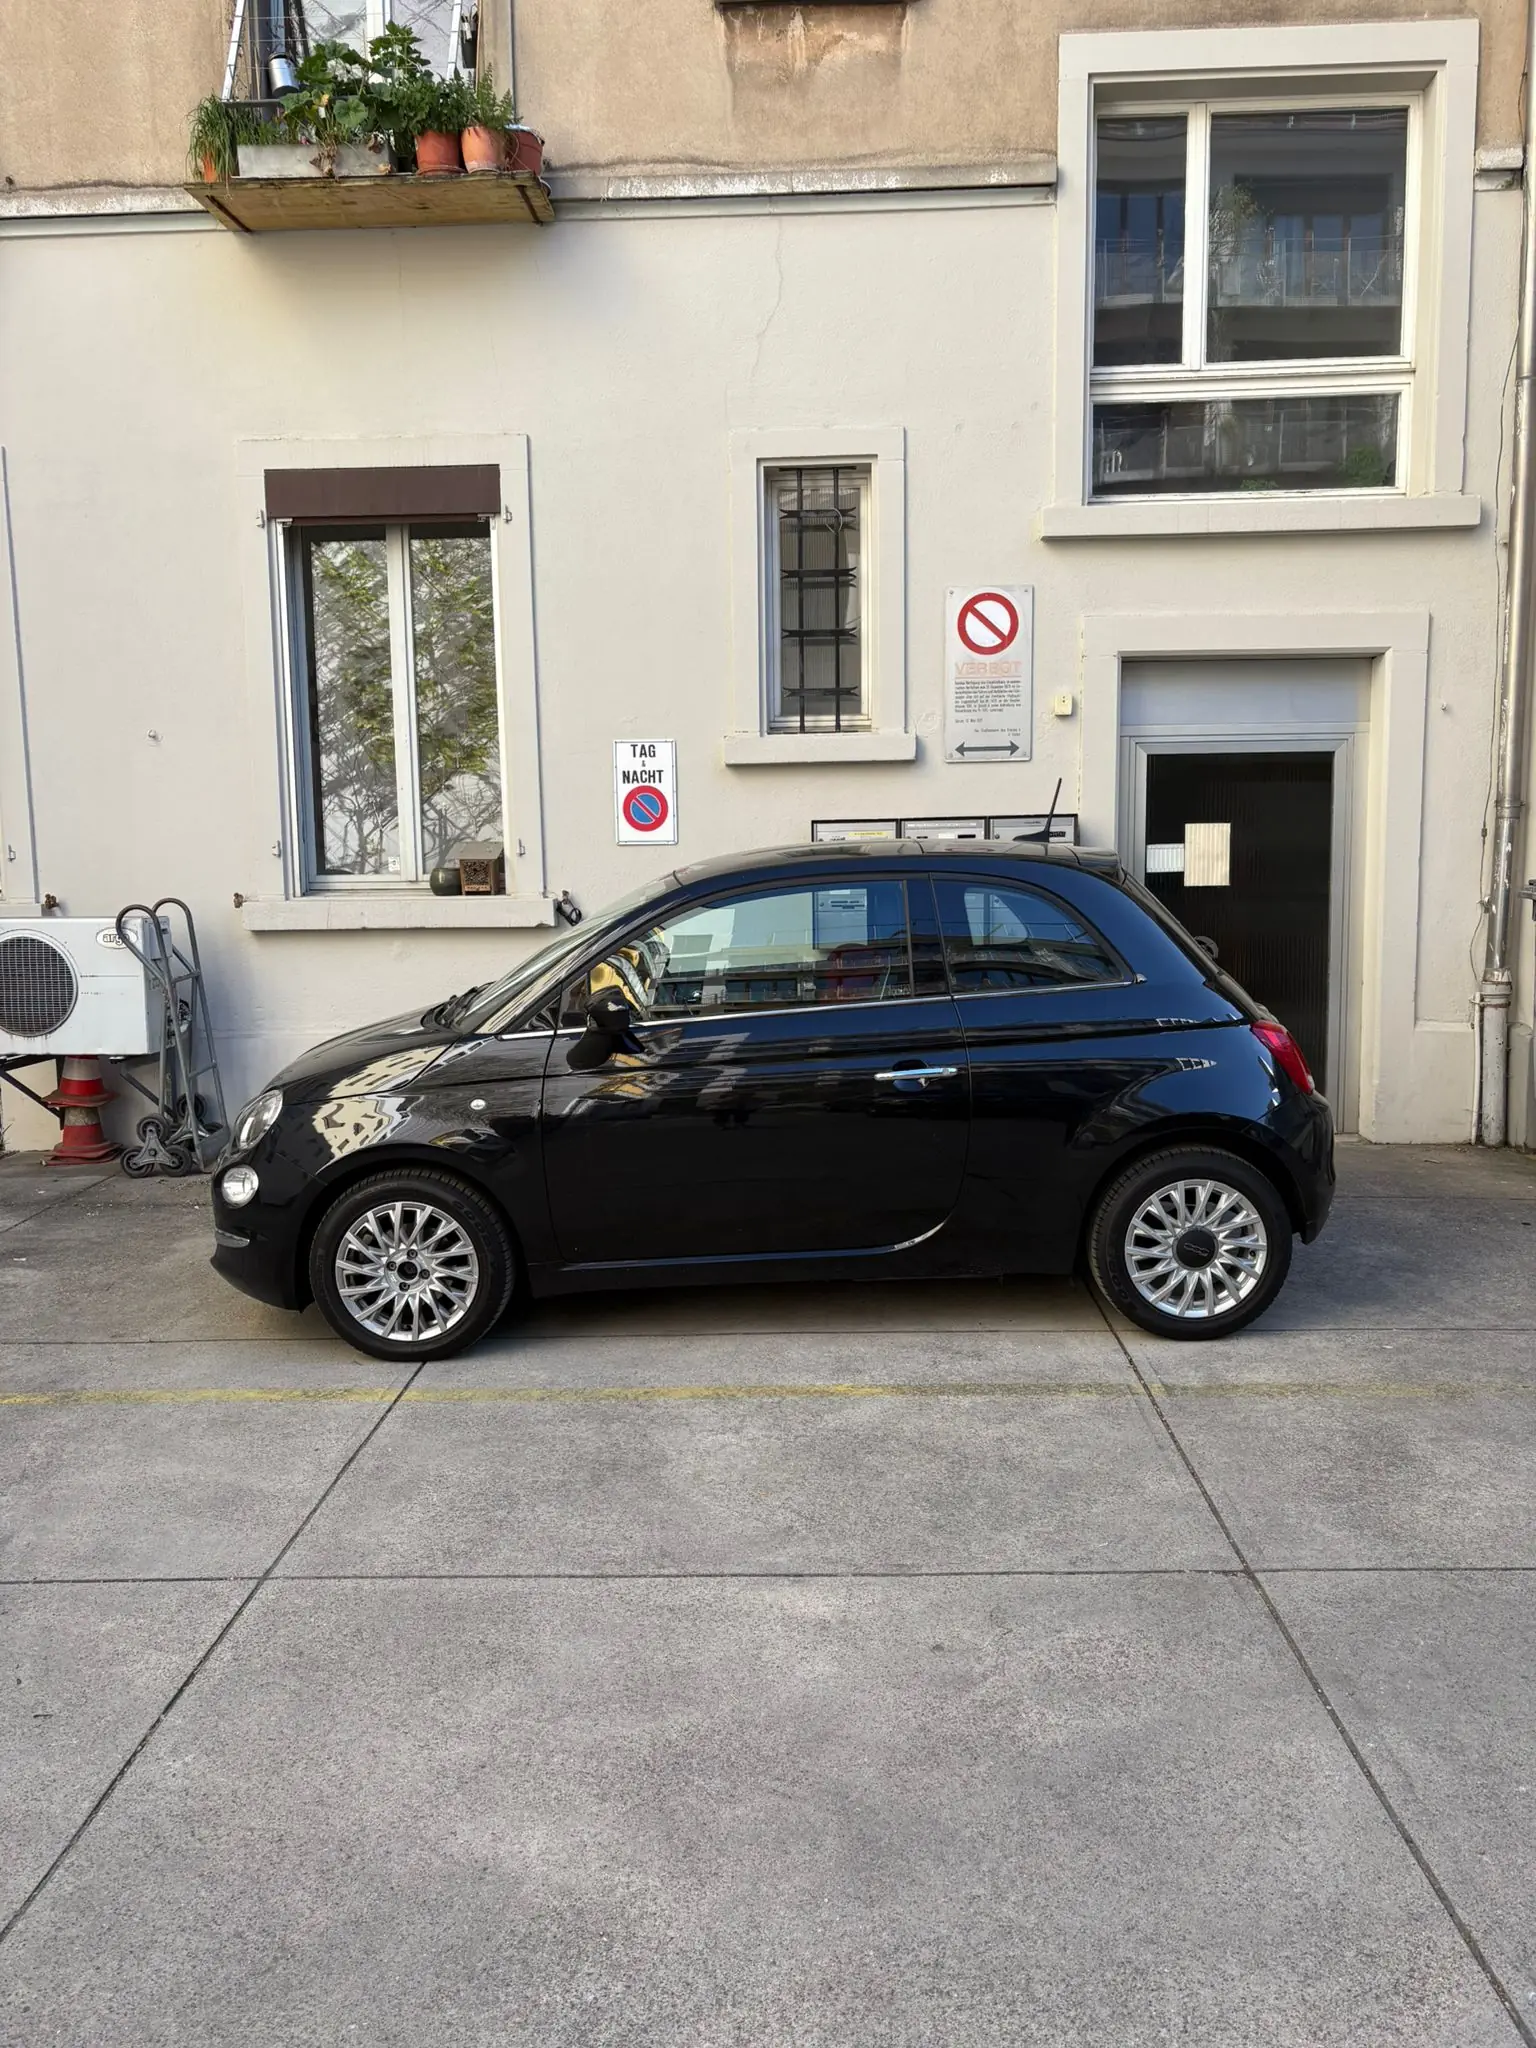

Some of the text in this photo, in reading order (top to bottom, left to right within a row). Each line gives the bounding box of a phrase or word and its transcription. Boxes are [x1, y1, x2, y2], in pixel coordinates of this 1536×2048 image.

[955, 660, 1022, 675] VERBOT
[630, 744, 656, 758] TAG
[622, 769, 664, 784] NACHT
